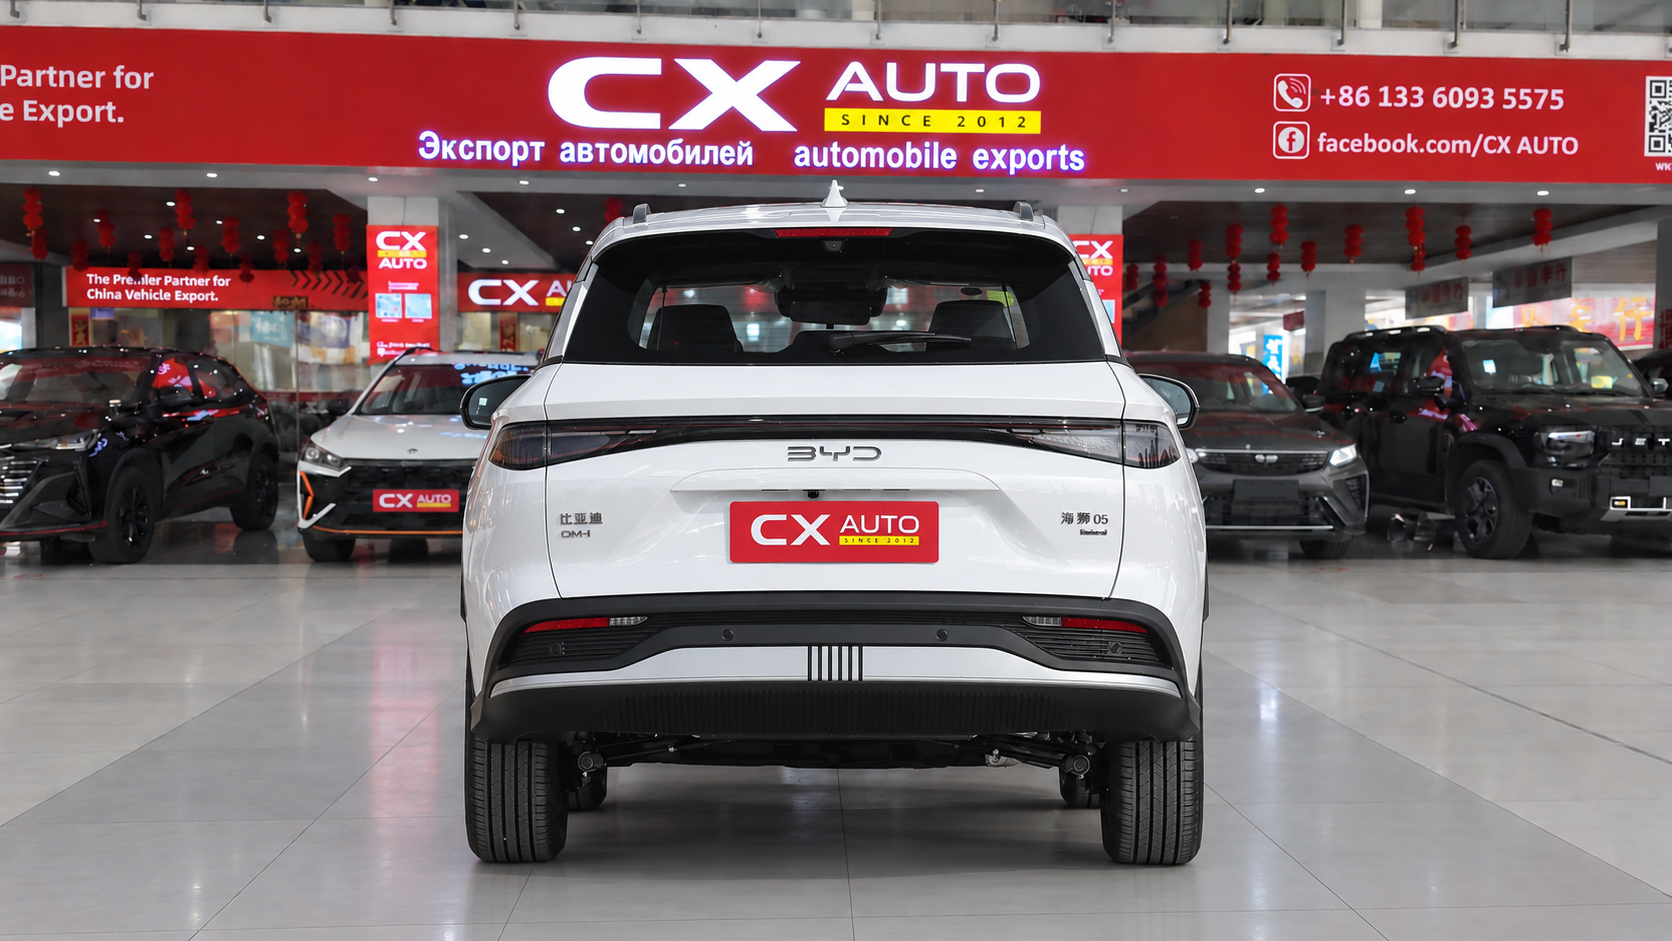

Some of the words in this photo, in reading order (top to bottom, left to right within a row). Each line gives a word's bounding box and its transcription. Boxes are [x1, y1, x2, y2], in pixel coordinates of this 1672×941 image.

[0, 64, 106, 89] Partner
[113, 65, 154, 90] for
[547, 57, 801, 132] CX
[826, 61, 1041, 103] AUTO
[1320, 86, 1370, 107] +86
[1378, 86, 1424, 107] 133
[1432, 87, 1495, 109] 6093
[1502, 88, 1564, 110] 5575
[23, 100, 124, 128] Export.
[841, 114, 931, 127] SINCE
[957, 116, 1026, 128] 2012
[418, 130, 546, 167] Экспорт
[560, 138, 753, 166] автомобилей
[1317, 133, 1511, 158] facebook.com/CX
[1517, 136, 1579, 155] AUTO
[794, 141, 957, 169] automobile
[972, 144, 1085, 175] exports
[376, 231, 427, 251] CX
[378, 258, 428, 269] AUTO
[86, 274, 110, 285] The
[164, 276, 210, 287] Partner
[213, 275, 231, 287] for
[467, 279, 539, 305] CX
[86, 288, 122, 300] China
[125, 289, 171, 301] Vehicle
[174, 290, 219, 304] Export.
[787, 445, 882, 462] BYD
[379, 493, 413, 508] CX
[417, 494, 452, 503] AUTO
[560, 511, 603, 525] 比亚迪
[750, 514, 831, 546] CX
[839, 515, 920, 534] AUTO
